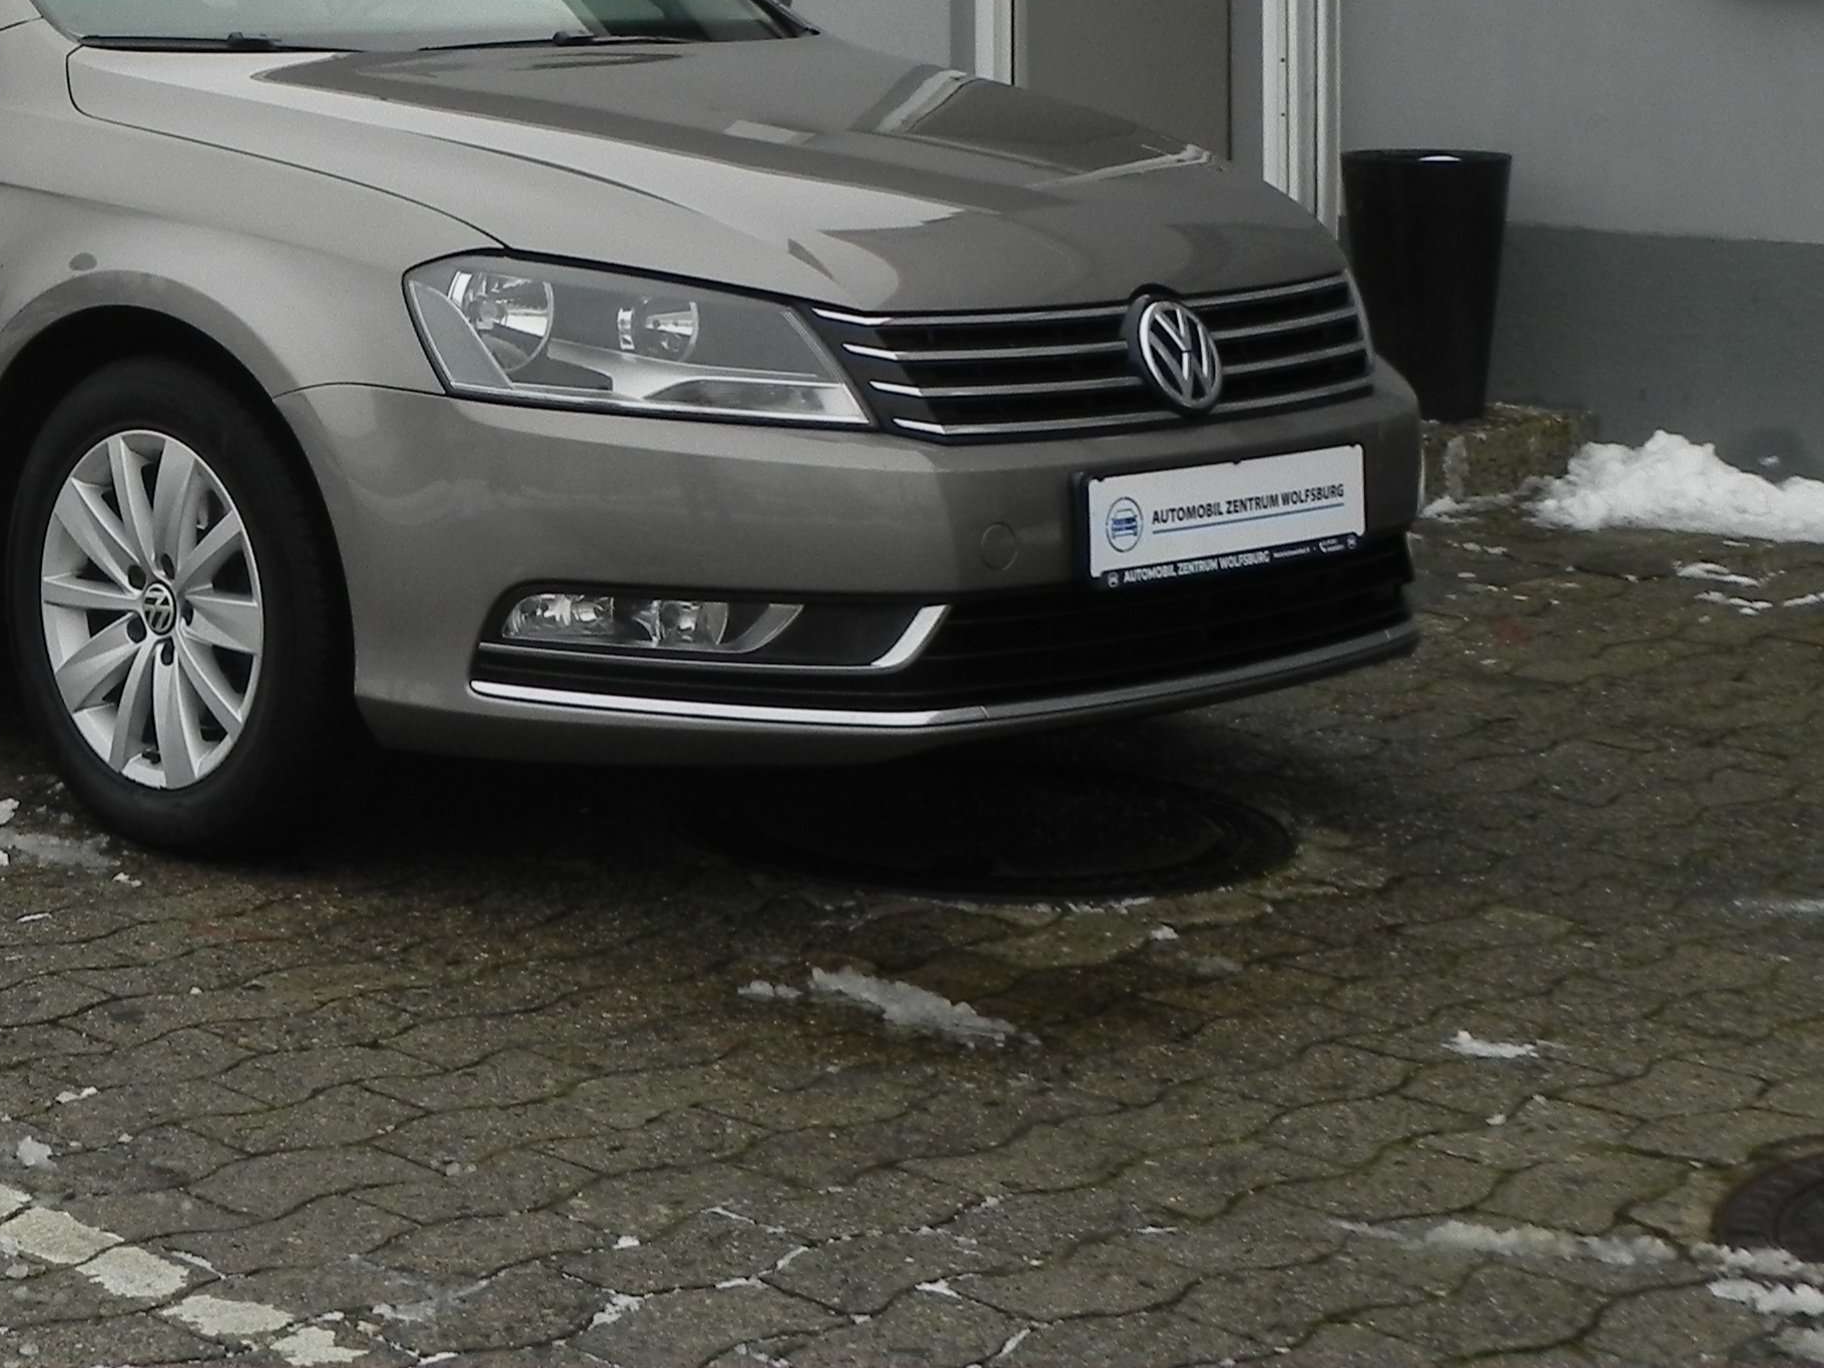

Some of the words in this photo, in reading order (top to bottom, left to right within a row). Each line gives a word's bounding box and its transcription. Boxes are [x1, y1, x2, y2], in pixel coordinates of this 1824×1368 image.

[1151, 503, 1224, 526] AUTOMOBIL
[1225, 493, 1279, 516] ZENTRUM
[1280, 483, 1345, 508] WOLFSBURG
[1123, 565, 1177, 584] AUTOMOBIL
[1177, 557, 1218, 577] ZENTRUM
[1219, 550, 1271, 570] WOLFSBURG
